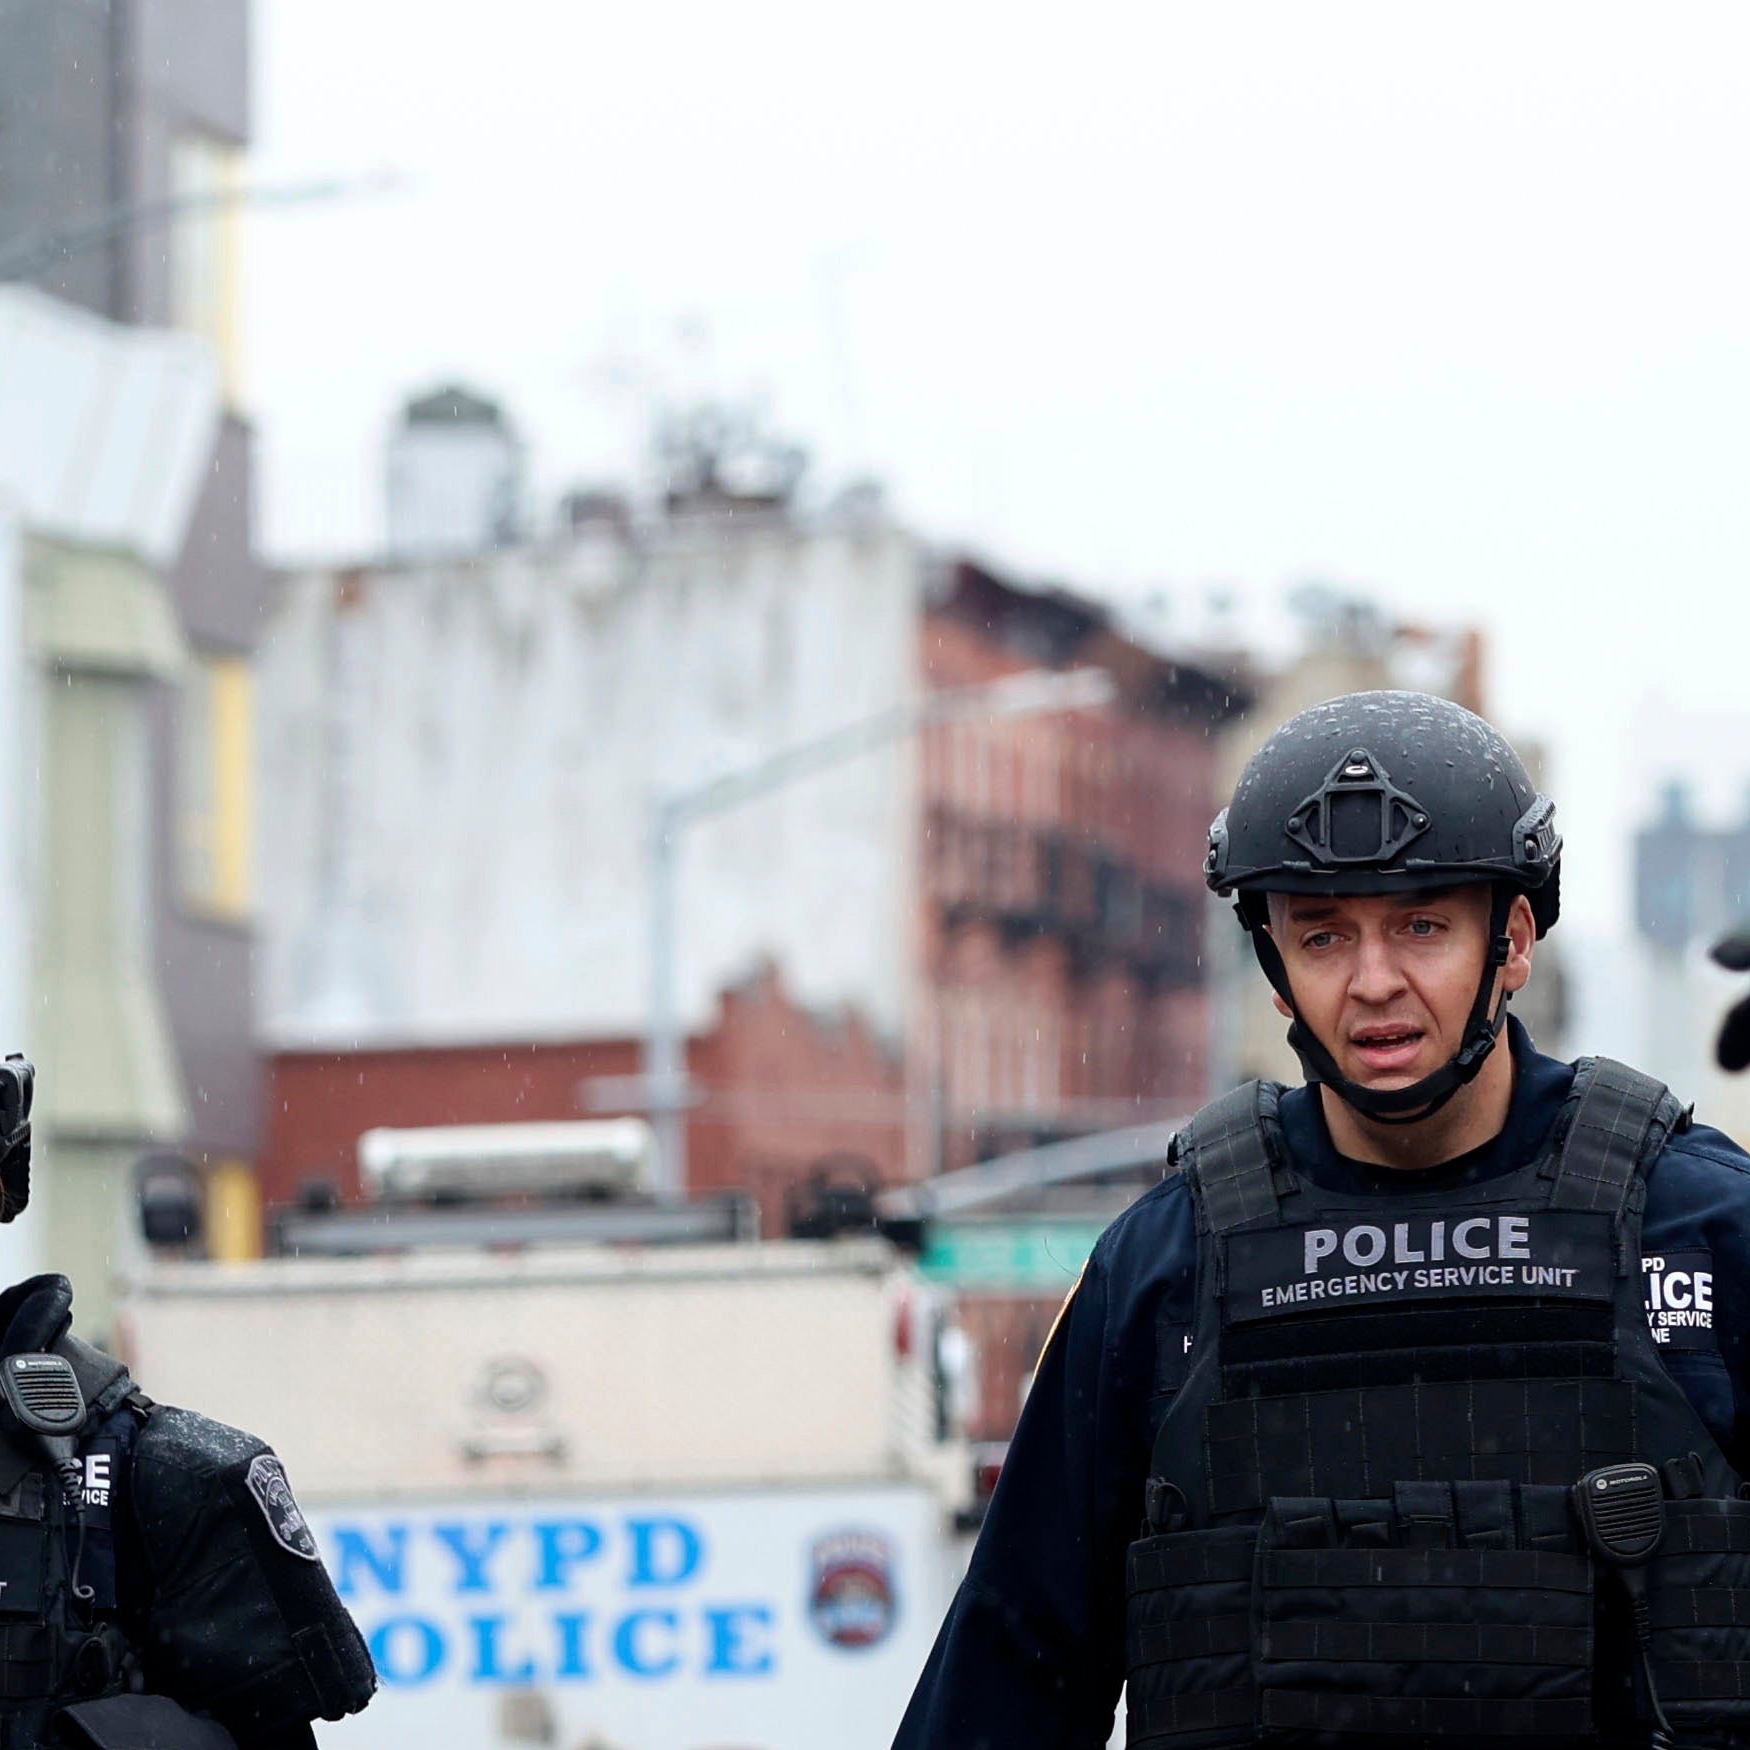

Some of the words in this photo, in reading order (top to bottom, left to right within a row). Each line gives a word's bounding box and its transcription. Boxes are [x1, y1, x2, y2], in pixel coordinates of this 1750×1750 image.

[1303, 1216, 1531, 1274] POLICE
[1641, 1257, 1665, 1272] PD
[1261, 1269, 1410, 1308] EMERGENCY
[1413, 1266, 1514, 1289] SERVICE
[1521, 1265, 1579, 1288] UNIT
[1645, 1271, 1713, 1311] ICE
[1658, 1310, 1712, 1328] SERVICE
[333, 1515, 707, 1594] NYPD
[369, 1608, 777, 1684] OLICE
